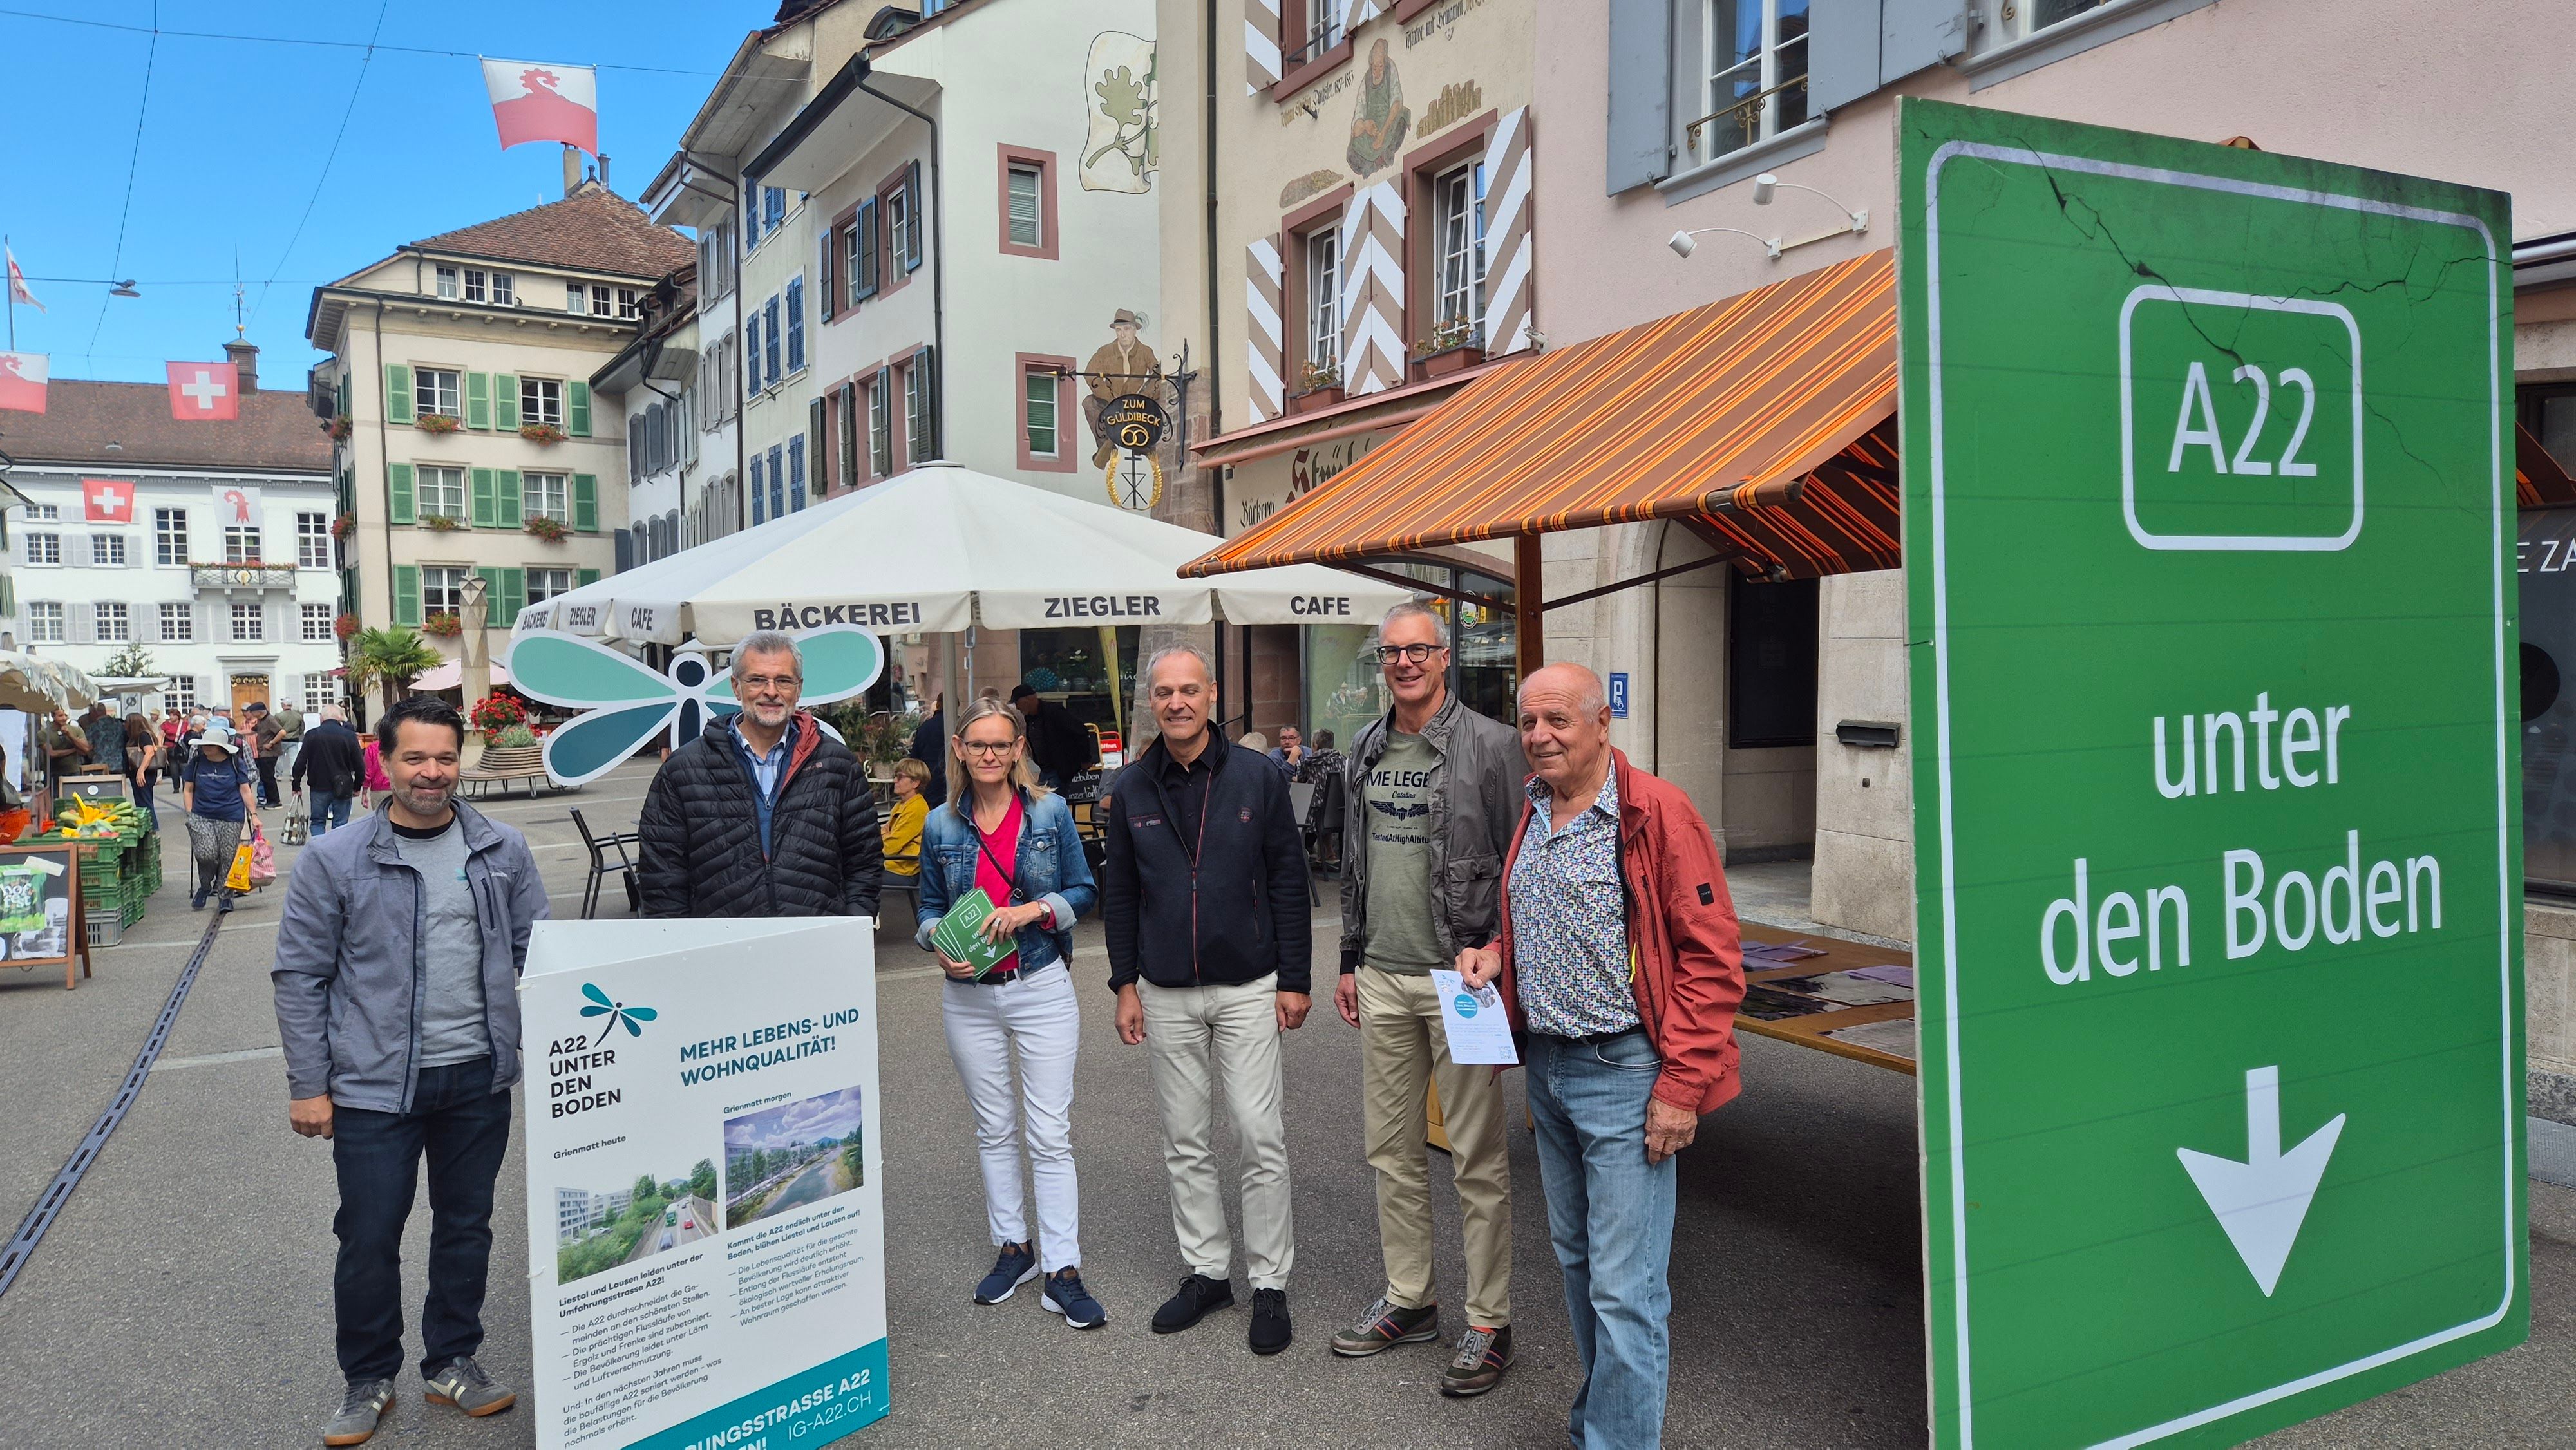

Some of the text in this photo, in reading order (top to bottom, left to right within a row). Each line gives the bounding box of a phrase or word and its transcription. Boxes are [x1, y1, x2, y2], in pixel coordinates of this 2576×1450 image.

[1106, 411, 1161, 427] GÜLDIBECK
[1122, 399, 1145, 409] ZUM
[2168, 361, 2317, 476] A22
[2539, 537, 2576, 572] ZA
[569, 607, 596, 626] ZIEGLER
[631, 607, 653, 631] CAFE
[754, 602, 920, 631] BÄCKEREI
[1044, 596, 1161, 618] ZIEGLER
[1290, 596, 1350, 616] CAFE
[2153, 691, 2351, 799] unter
[1366, 771, 1429, 787] ME LEGE
[1372, 832, 1430, 845] TestedAtHighAltitu
[965, 909, 978, 923] A22
[2040, 829, 2441, 986] den Boden
[968, 941, 980, 952] den
[549, 1035, 587, 1057] A22
[680, 1008, 860, 1062] MEHR LEBENS- UND
[550, 1050, 616, 1077] UNTER
[680, 1035, 836, 1088] WOHNQUALITÄT!
[551, 1075, 592, 1098] DEN
[551, 1088, 621, 1118] BODEN
[723, 1091, 792, 1114] Grienmatt morgen
[553, 1135, 627, 1160] Grienmatt heute
[727, 1206, 844, 1250] Kommt die A22 endlich unter den
[727, 1248, 753, 1260] Boden,
[755, 1238, 780, 1251] blühen
[781, 1227, 805, 1242] Liestal
[806, 1223, 820, 1233] und
[820, 1216, 846, 1229] Lausen
[738, 1228, 858, 1274] Die Lebensqualität für die gesamte
[738, 1265, 782, 1285] Bevölkerung
[783, 1257, 799, 1268] wird
[800, 1248, 828, 1263] deutlich
[559, 1254, 703, 1307] Liestal und Lausen leiden unter der
[739, 1252, 846, 1295] Entlang der Flussläufe entsteht
[739, 1286, 777, 1306] ökologisch
[778, 1274, 813, 1292] wertvoller
[559, 1276, 664, 1318] Umfahrungsstrasse A22!
[572, 1285, 699, 1333] Die A22 durchschneidet die Ge-
[739, 1271, 849, 1317] An bester Lage kann attraktiver
[739, 1308, 779, 1326] Wohnraum
[781, 1292, 820, 1313] geschaffen
[572, 1291, 710, 1345] meinden an den schönsten Stellen.
[573, 1308, 691, 1356] Die prächtigen Flussläufe von
[573, 1312, 712, 1368] Ergolz und Frenke sind zubetoniert.
[574, 1324, 708, 1379] Die Bevölkerung leidet unter Lärm
[563, 1400, 583, 1413] Und:
[595, 1391, 611, 1401] den
[613, 1375, 651, 1395] nächsten
[652, 1363, 680, 1379] Jahren
[682, 1355, 702, 1367] muss
[574, 1349, 673, 1390] und Luftverschmutzung.
[838, 1368, 871, 1396] A22
[564, 1415, 576, 1426] die
[579, 1398, 620, 1420] baufällige
[622, 1389, 639, 1402] A22
[640, 1379, 668, 1395] saniert
[670, 1367, 699, 1382] werden
[706, 1358, 722, 1368] was
[564, 1374, 708, 1436] die Belastungen für die Bevölkerung
[564, 1415, 637, 1449] nochmals erhöht.
[788, 1390, 871, 1441] IG-A22.CH
